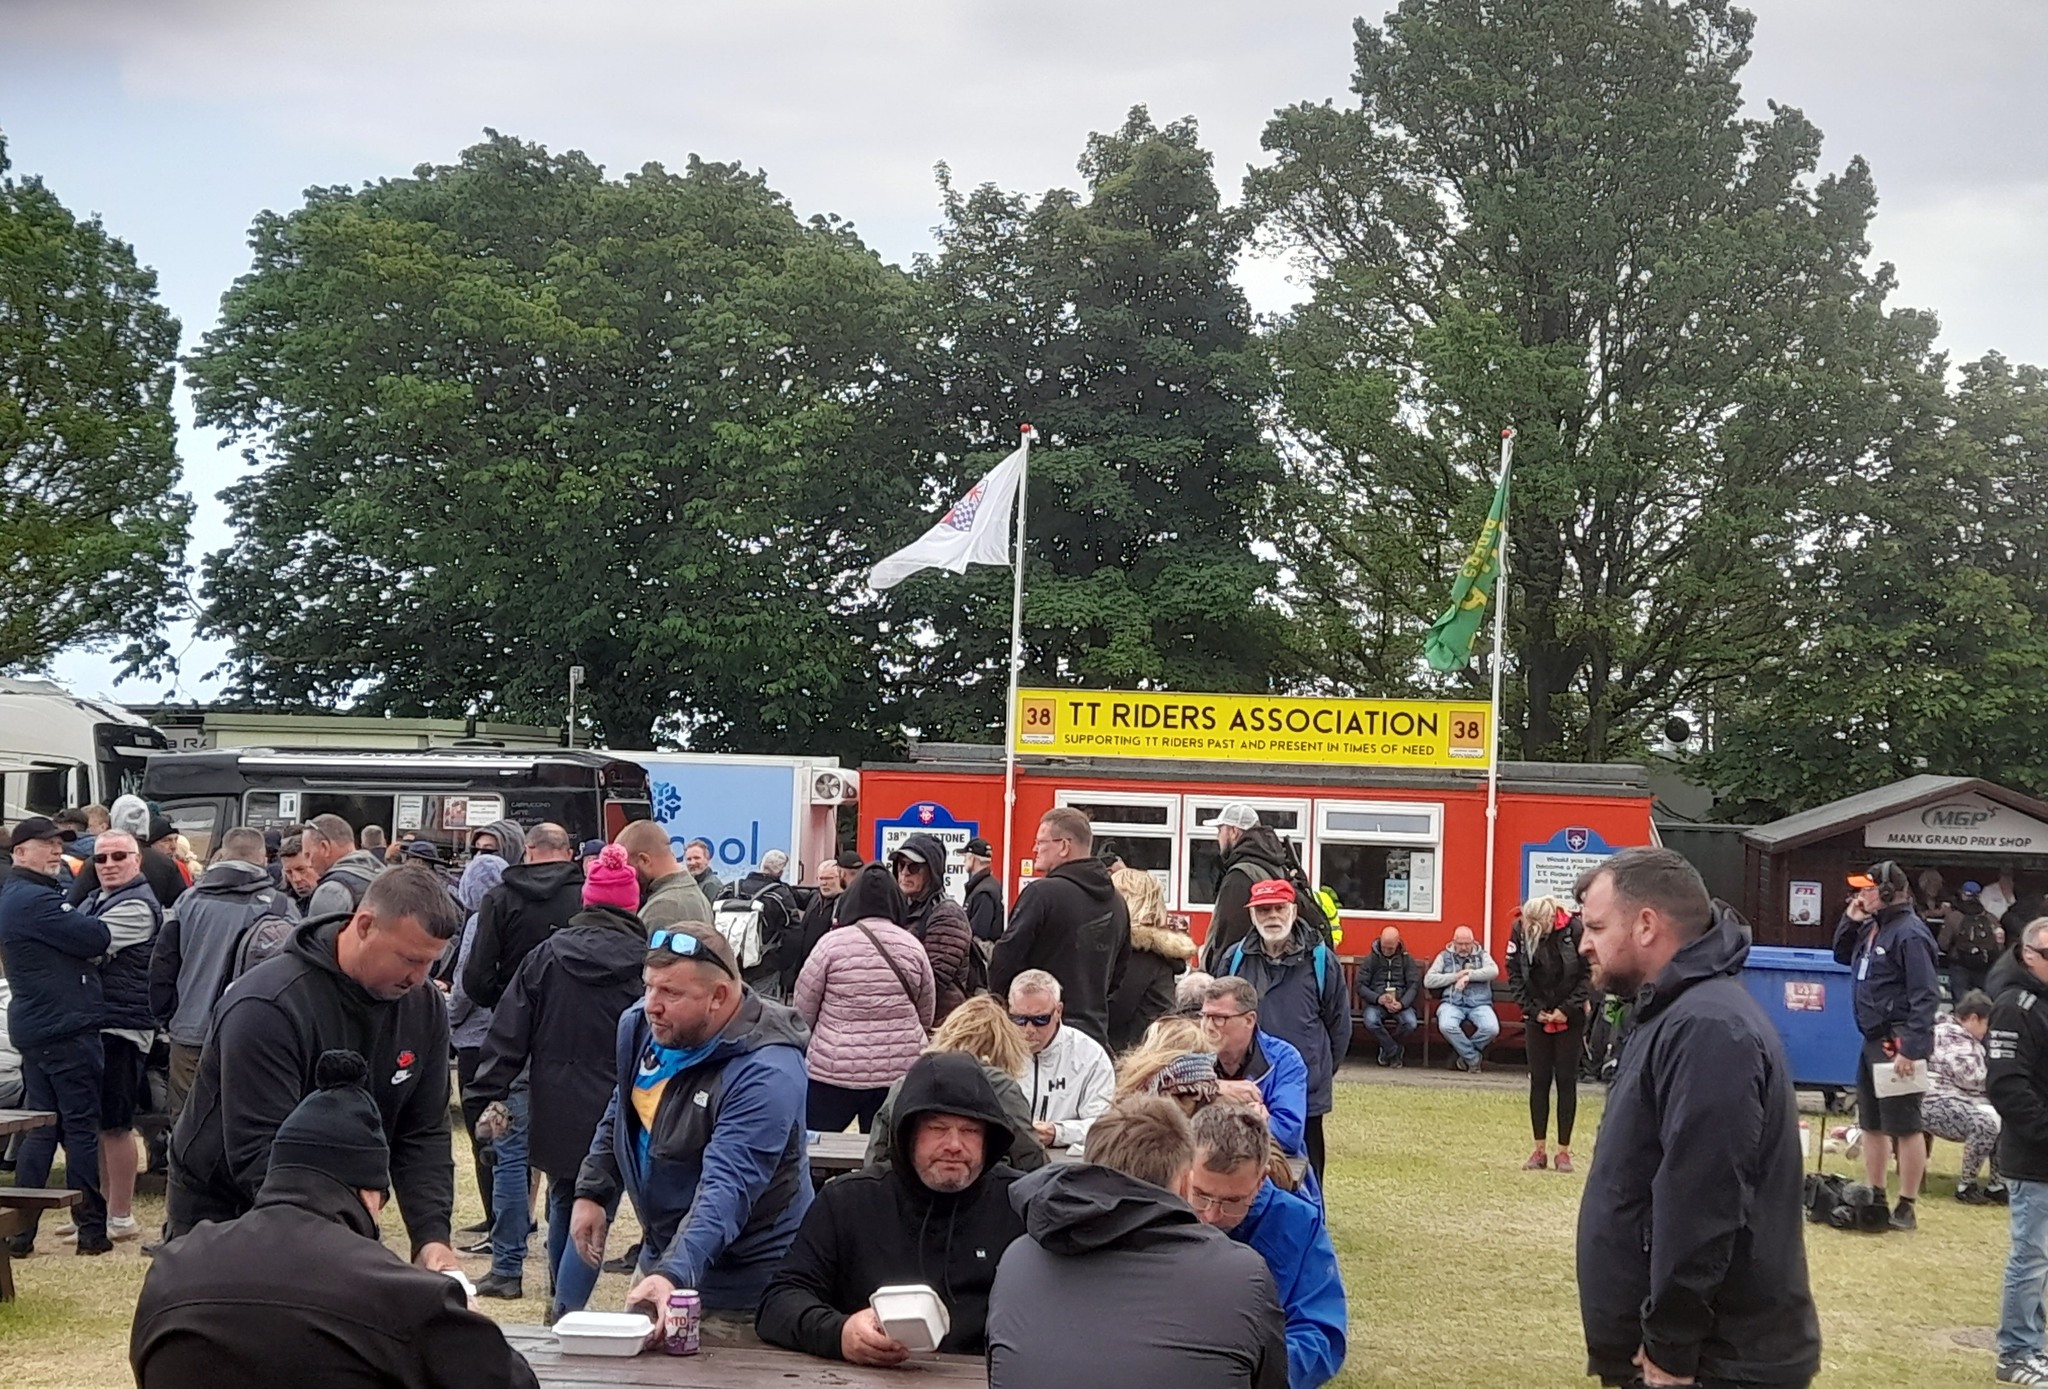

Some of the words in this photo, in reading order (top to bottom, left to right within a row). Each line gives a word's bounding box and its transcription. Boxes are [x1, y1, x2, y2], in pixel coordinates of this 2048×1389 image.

[1026, 707, 1051, 726] 38
[1069, 702, 1101, 727] TT
[1112, 703, 1216, 730] RIDERS
[1228, 707, 1438, 737] ASSOCIATION
[1453, 720, 1480, 739] 38
[1064, 734, 1141, 746] SUPPORTING
[1145, 736, 1159, 746] TT
[1161, 737, 1204, 748] RIDERS
[1207, 738, 1235, 749] PAST
[1240, 739, 1266, 750] AND
[1269, 740, 1323, 752] PRESENT
[1327, 742, 1339, 752] IN
[1343, 742, 1377, 754] TIMES
[1380, 744, 1398, 754] OF
[1402, 745, 1435, 756] NEED
[1932, 810, 1989, 828] MGP
[928, 832, 966, 843] STONE
[1887, 833, 1923, 845] MANX
[1925, 834, 1968, 846] GRAND
[1970, 836, 1997, 847] PRIX
[1999, 837, 2032, 848] SHOP
